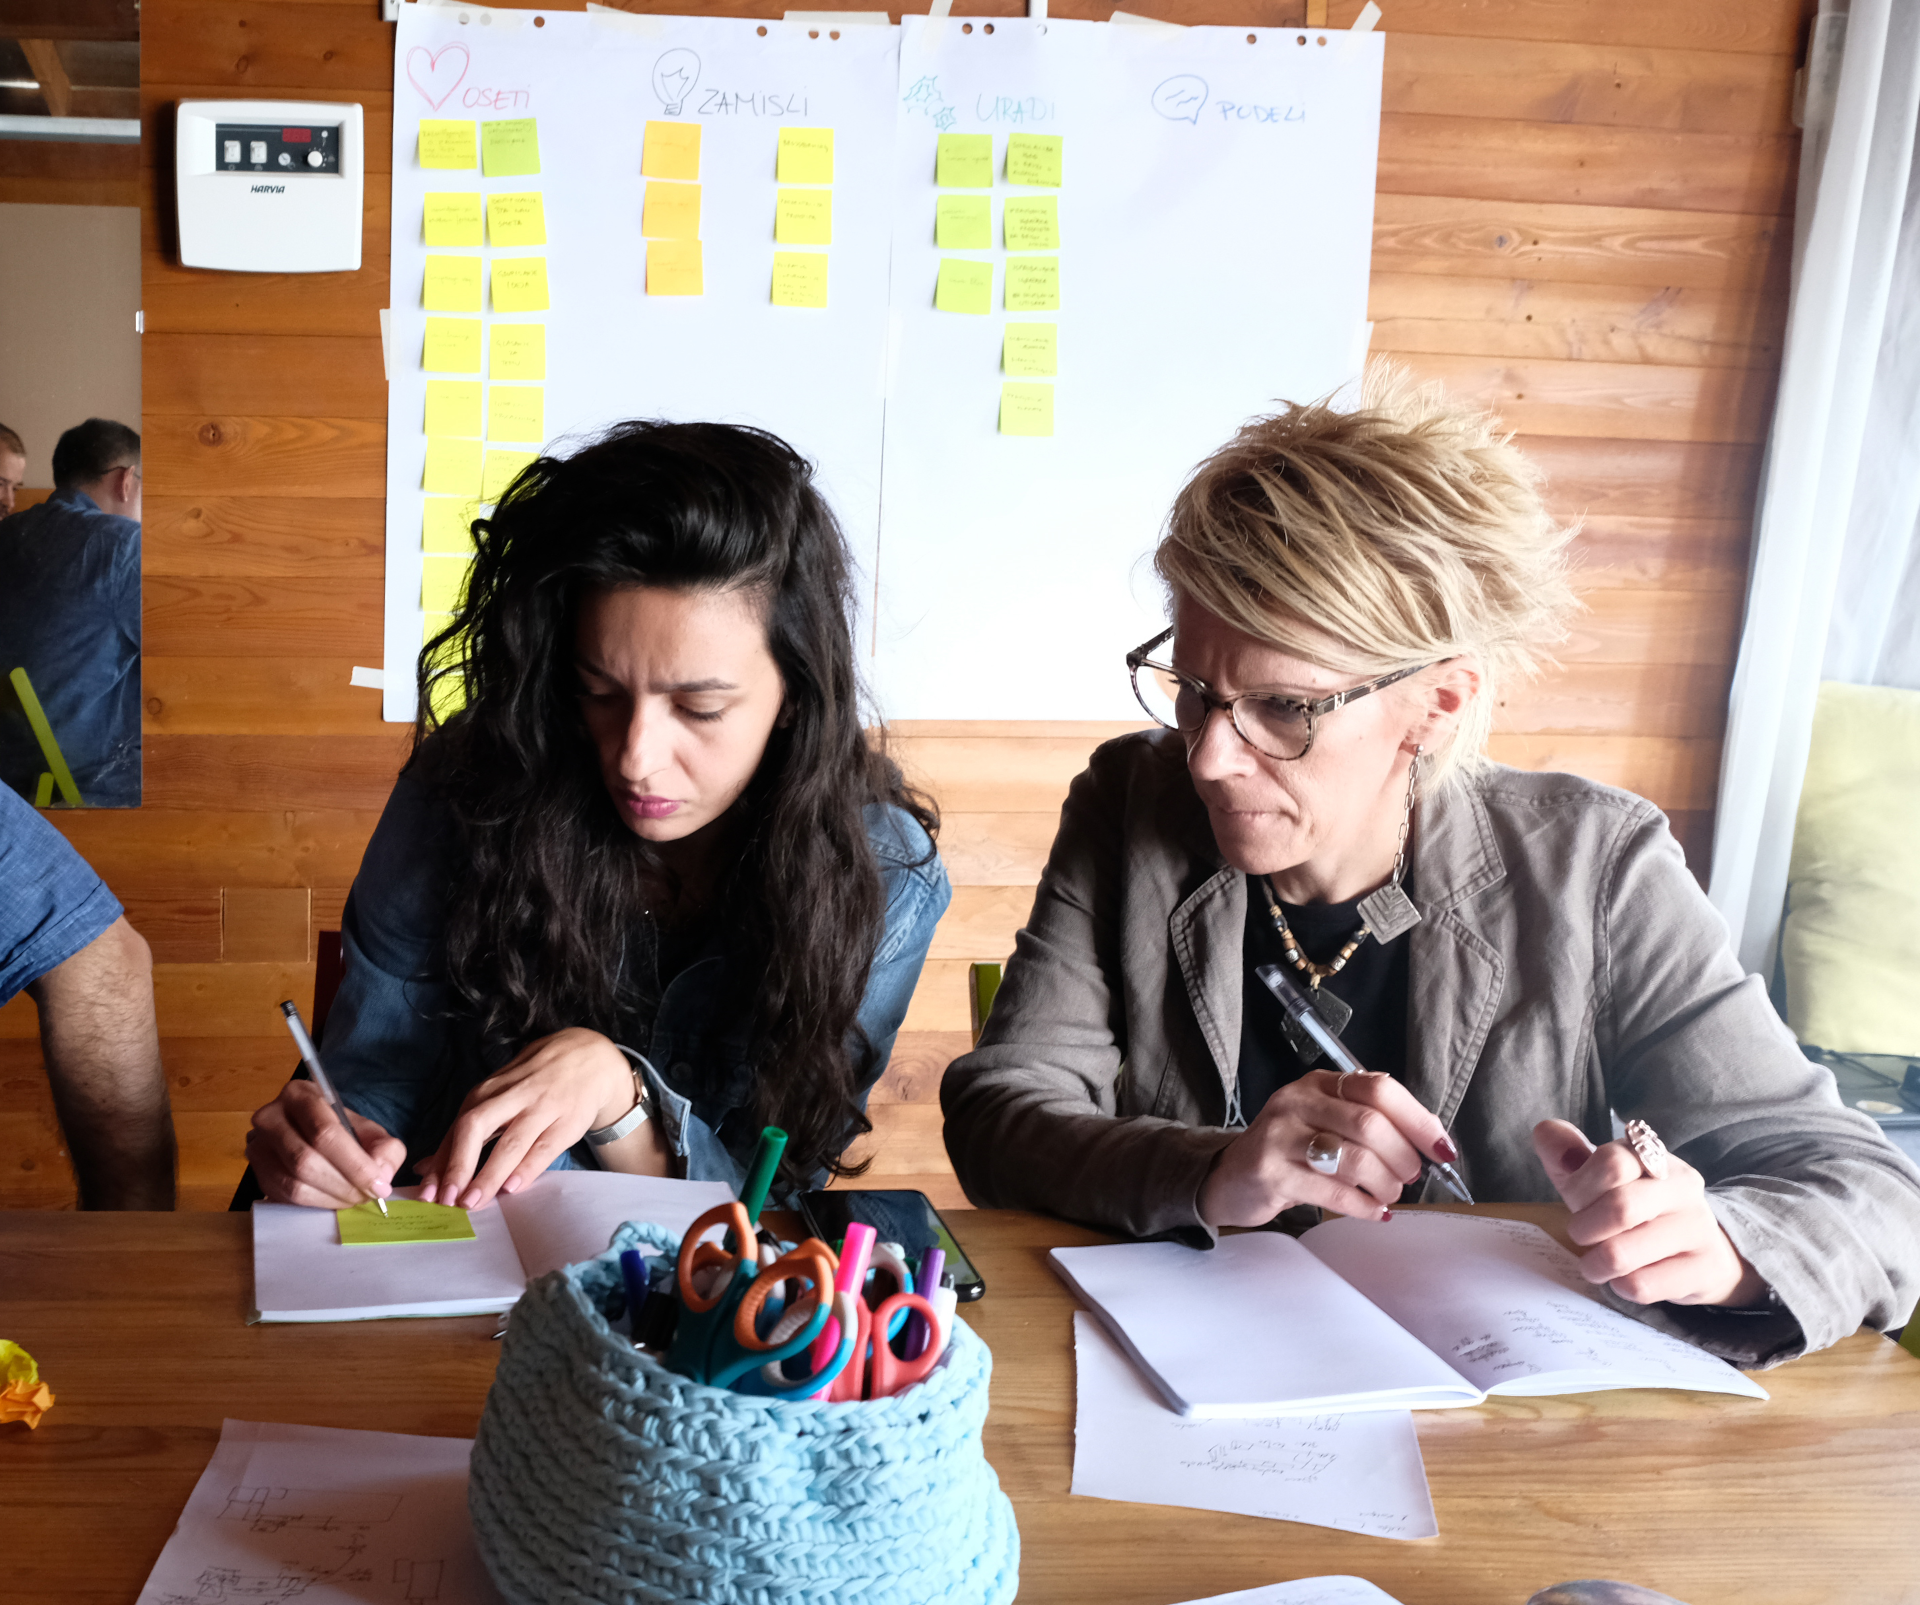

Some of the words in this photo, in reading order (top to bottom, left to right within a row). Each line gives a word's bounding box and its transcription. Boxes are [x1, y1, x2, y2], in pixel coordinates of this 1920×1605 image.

[463, 84, 530, 110] OSETI
[697, 85, 808, 117] ZAMISLI
[976, 93, 1055, 124] URADI
[1215, 100, 1306, 124] PODELI
[250, 184, 286, 194] HARVIA
